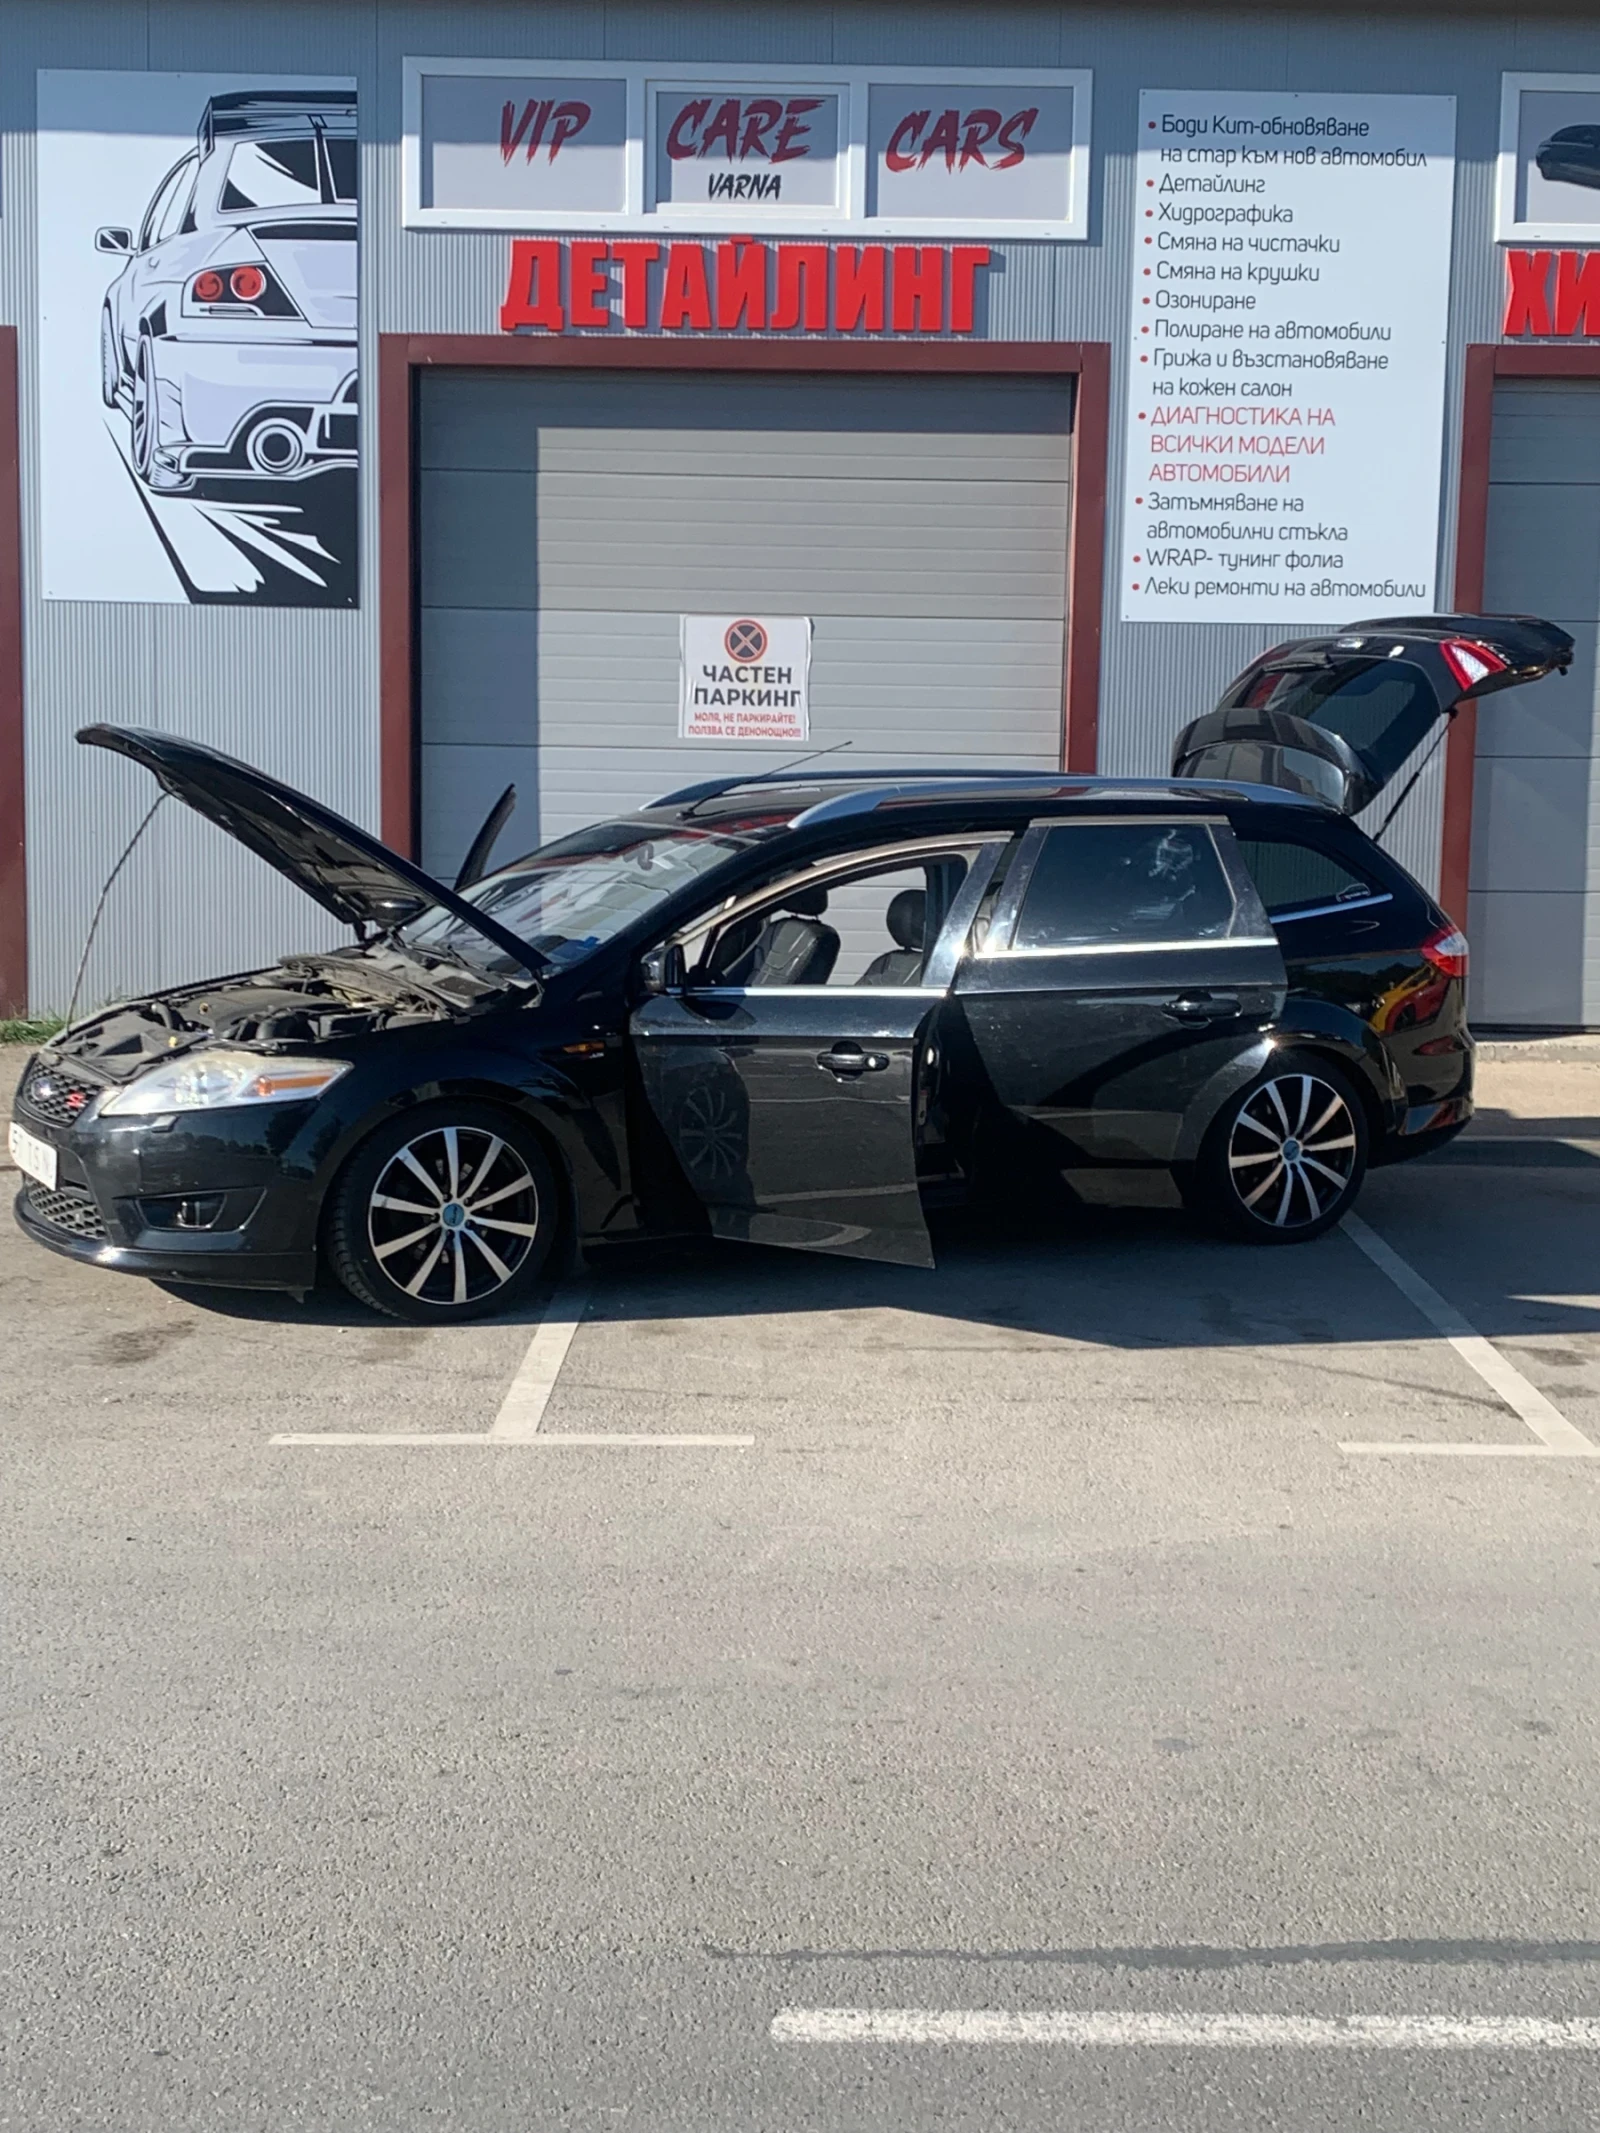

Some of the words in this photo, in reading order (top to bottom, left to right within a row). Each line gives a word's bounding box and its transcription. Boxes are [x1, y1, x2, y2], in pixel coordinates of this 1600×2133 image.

[500, 98, 592, 167] VIP
[666, 97, 826, 164] CARE
[885, 107, 1040, 174] CARS
[1162, 114, 1208, 138] Боди
[1213, 115, 1369, 137] Кит-обновяване
[1161, 148, 1182, 162] на
[1187, 148, 1237, 168] стар
[1242, 145, 1278, 164] към
[1283, 146, 1316, 165] нов
[1321, 146, 1427, 167] автомобил
[707, 173, 781, 200] VARNA
[1159, 173, 1265, 194] Детайлинг
[1158, 202, 1293, 226] Хидрографика
[1158, 232, 1217, 251] Смяна
[1222, 237, 1243, 251] на
[1248, 234, 1340, 253] чистачки
[501, 235, 990, 332] ДЕТАЙЛИНГ
[1157, 261, 1215, 280] Смяна
[1221, 266, 1242, 280] на
[1248, 262, 1319, 285] крушки
[1156, 289, 1256, 312] Озониране
[1155, 319, 1244, 342] Полиране
[1249, 325, 1270, 339] на
[1274, 321, 1391, 341] автомобили
[1154, 348, 1211, 370] Грижа
[1216, 353, 1227, 367] и
[1232, 349, 1388, 369] възстановяване
[1153, 381, 1174, 395] на
[1179, 377, 1236, 396] кожен
[1241, 382, 1292, 397] салон
[1151, 406, 1302, 426] ДИАГНОСТИКА
[1308, 408, 1335, 426] НА
[1151, 435, 1233, 453] ВСИЧКИ
[1239, 436, 1324, 457] МОДЕЛИ
[1149, 464, 1289, 483] АВТОМОБИЛИ
[1148, 492, 1278, 511] Затъмняване
[1283, 498, 1304, 512] на
[1147, 520, 1273, 540] автомобилни
[1279, 523, 1348, 541] стъкла
[1146, 548, 1213, 566] WRAP-
[1218, 553, 1281, 571] тунинг
[1285, 550, 1343, 572] фолиа
[1145, 576, 1190, 595] Леки
[1195, 581, 1279, 598] ремонти
[1284, 583, 1305, 596] на
[1310, 578, 1426, 598] автомобили
[703, 665, 792, 684] ЧАСТЕН
[695, 688, 801, 707] ПАРКИНГ
[695, 712, 721, 722] МОЛЯ,
[724, 713, 734, 722] НЕ
[737, 712, 795, 723] ПАРКИРАЙТЕ!
[689, 725, 722, 735] ПОЛЗВА
[726, 726, 735, 735] СЕ
